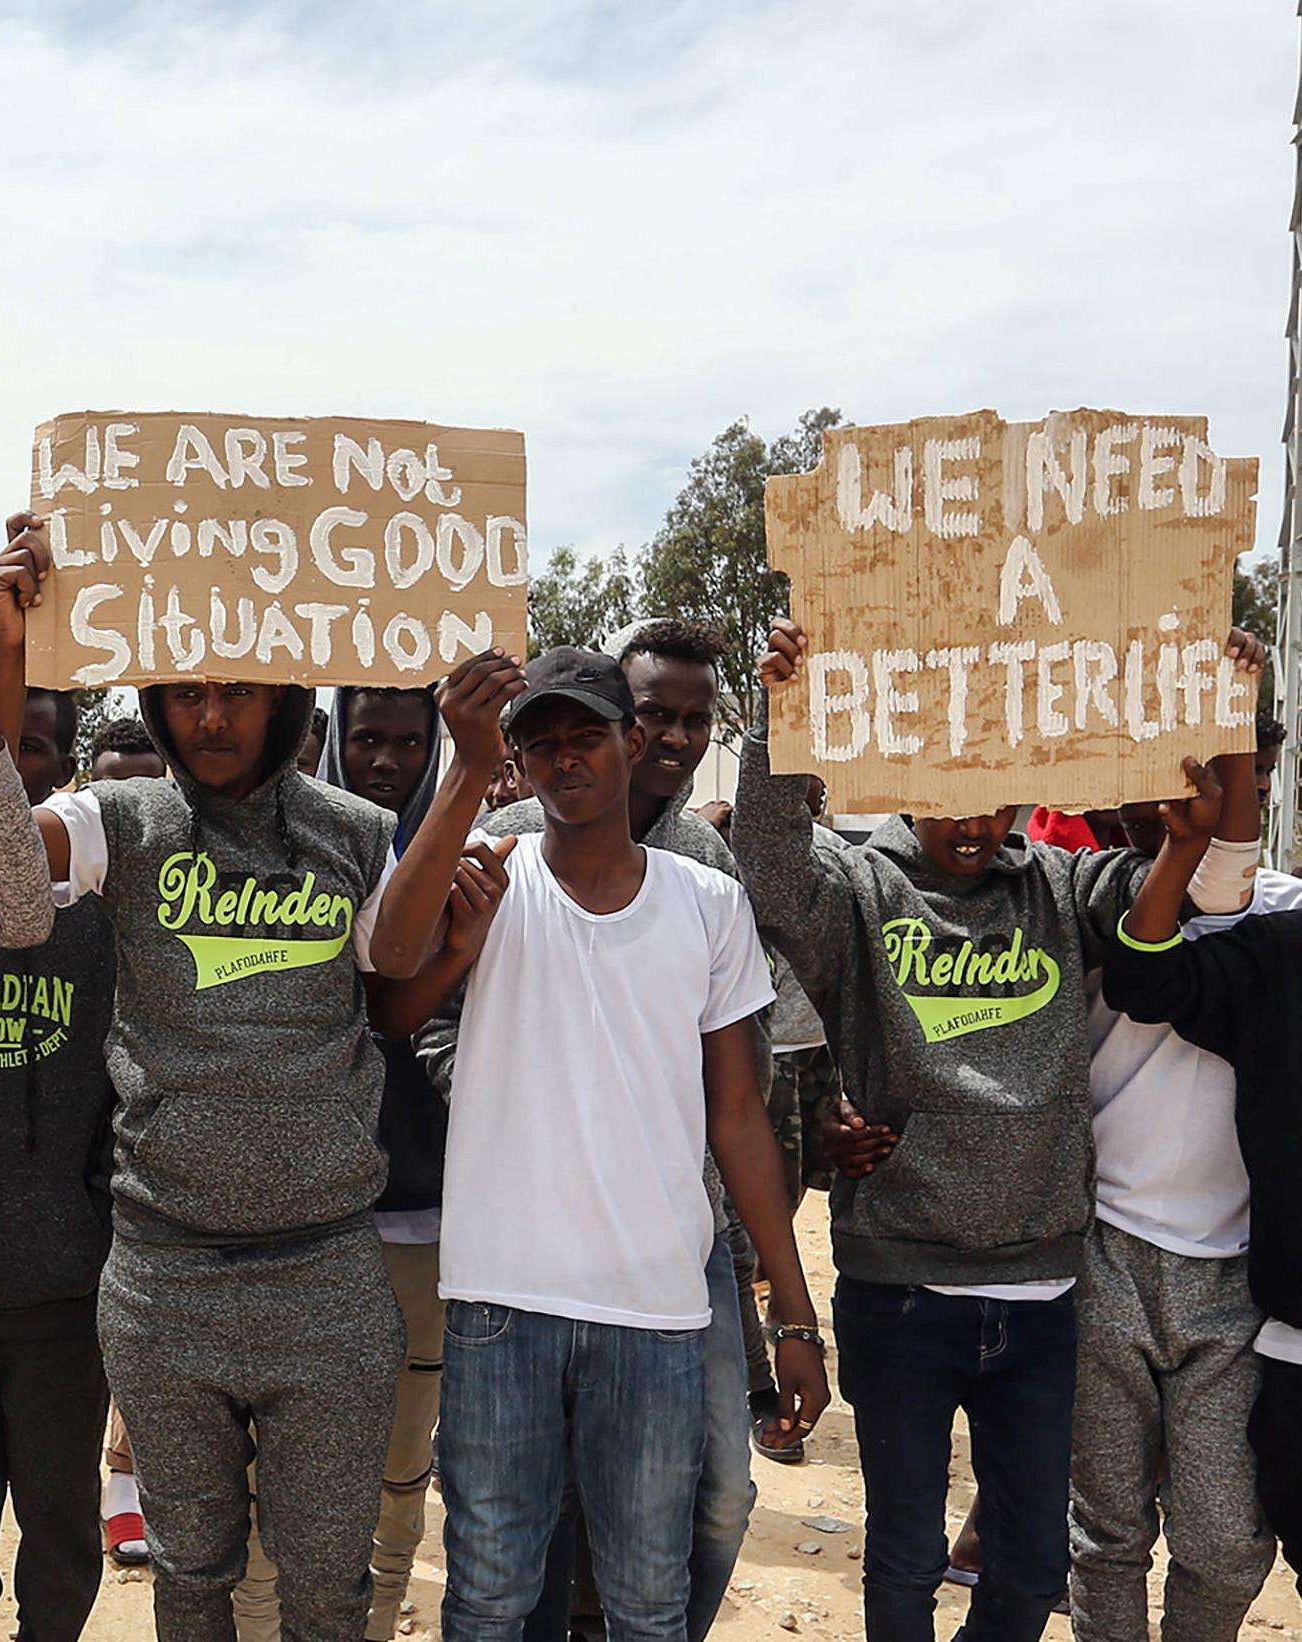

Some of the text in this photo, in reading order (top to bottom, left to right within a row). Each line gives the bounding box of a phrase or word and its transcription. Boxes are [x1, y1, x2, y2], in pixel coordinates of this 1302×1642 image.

[38, 423, 140, 498] WE
[166, 424, 313, 490] ARE
[836, 419, 1226, 539] WE NEED
[310, 505, 527, 592] GOOD
[996, 535, 1064, 626] A
[214, 949, 288, 980] PLAFODAHFE
[39, 1027, 68, 1057] DEPT
